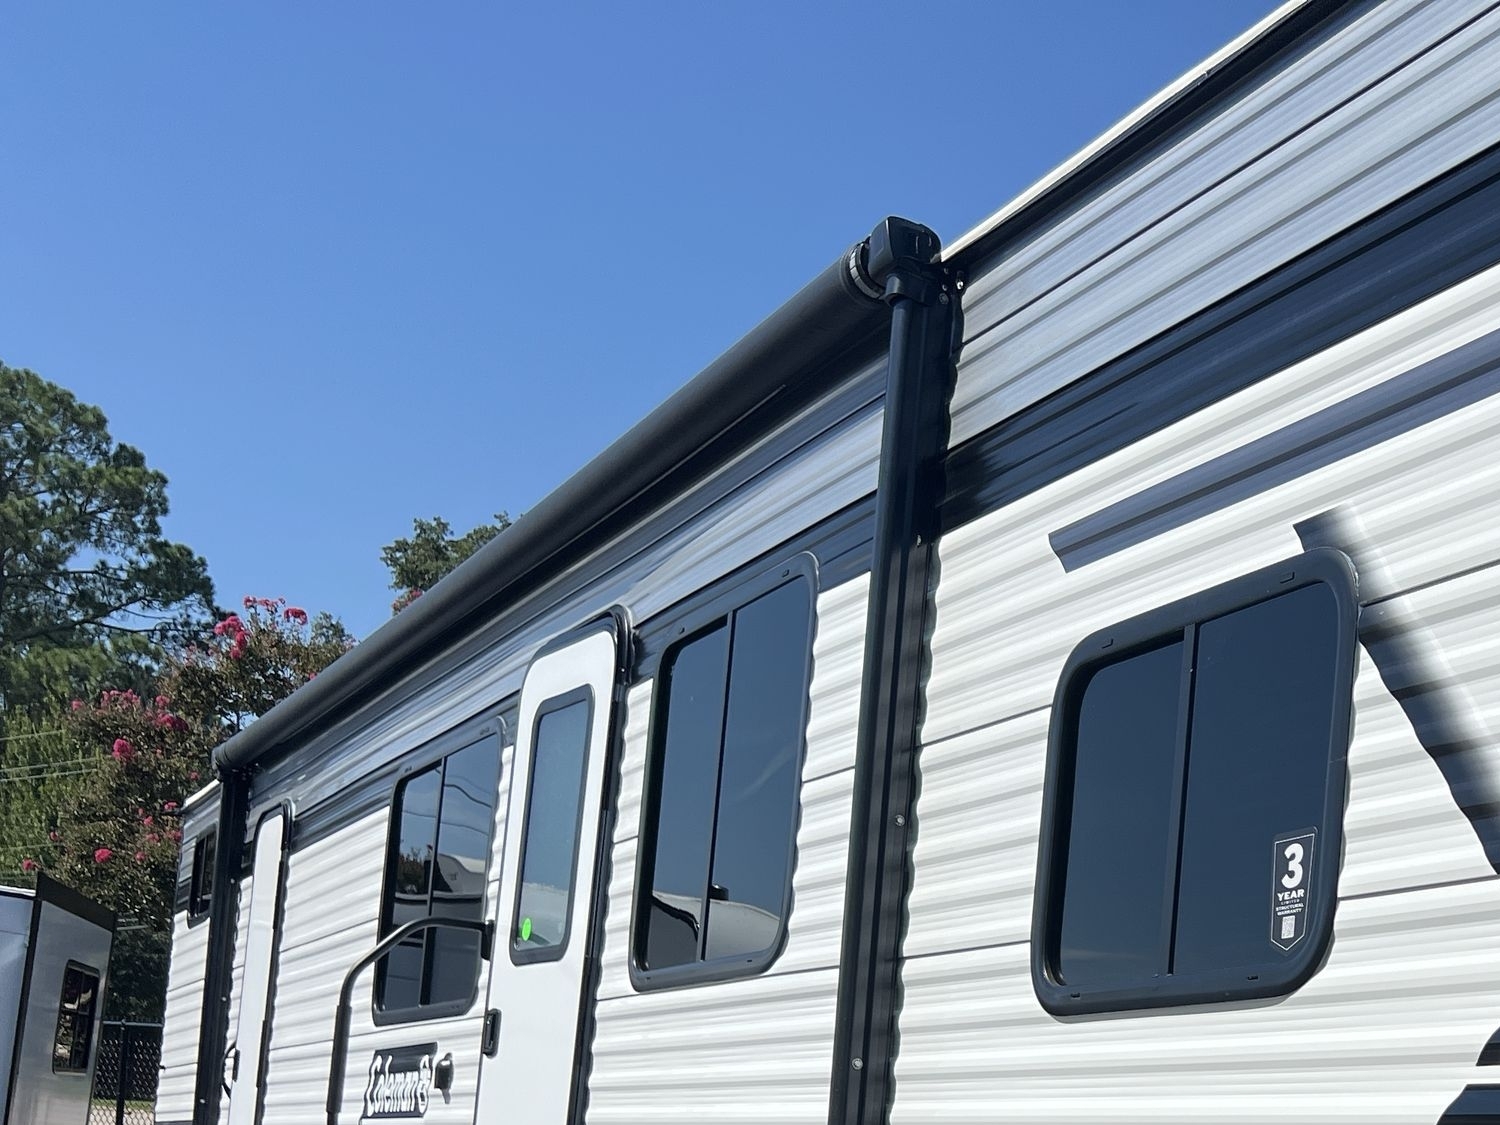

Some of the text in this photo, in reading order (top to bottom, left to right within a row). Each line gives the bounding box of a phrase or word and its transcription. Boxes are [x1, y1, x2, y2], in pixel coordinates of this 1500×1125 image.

[1281, 842, 1304, 889] 3
[1277, 888, 1305, 901] YEAR
[1277, 908, 1302, 916] WARRANTY
[366, 1055, 419, 1117] Coleman
